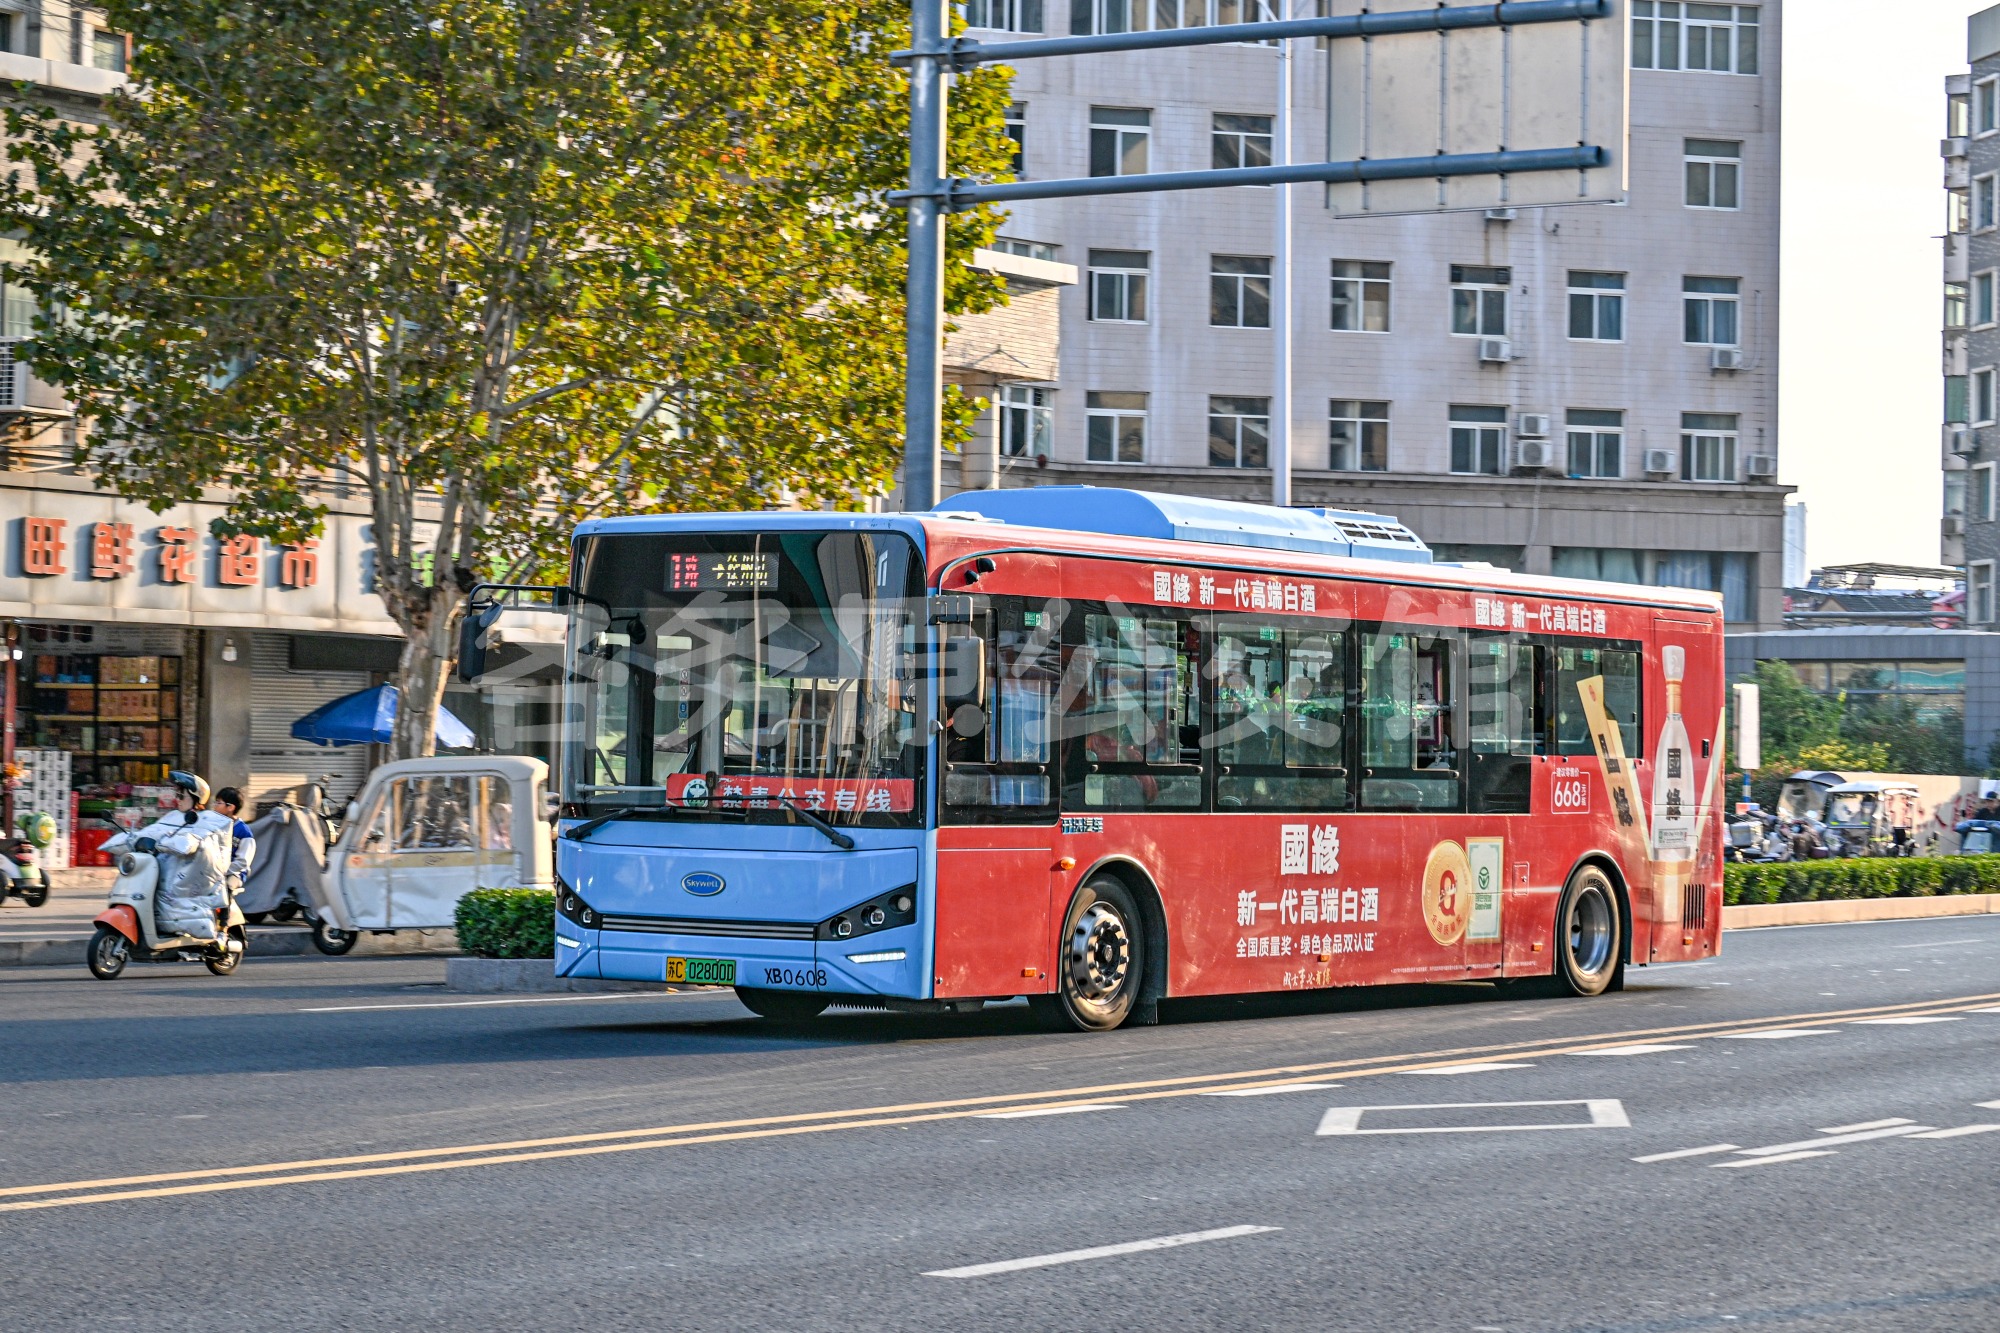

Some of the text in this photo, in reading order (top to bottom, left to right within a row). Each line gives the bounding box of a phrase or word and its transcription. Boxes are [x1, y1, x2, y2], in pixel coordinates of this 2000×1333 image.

[24, 517, 319, 588] 旺鲜花超市
[1199, 576, 1316, 612] 新一代高端白酒
[1512, 602, 1606, 634] 新一代高端白酒
[723, 785, 891, 812] 禁毒公交专线
[1554, 781, 1581, 807] 668
[1237, 887, 1379, 926] 新一代高端白酒
[764, 968, 827, 986] XB0608
